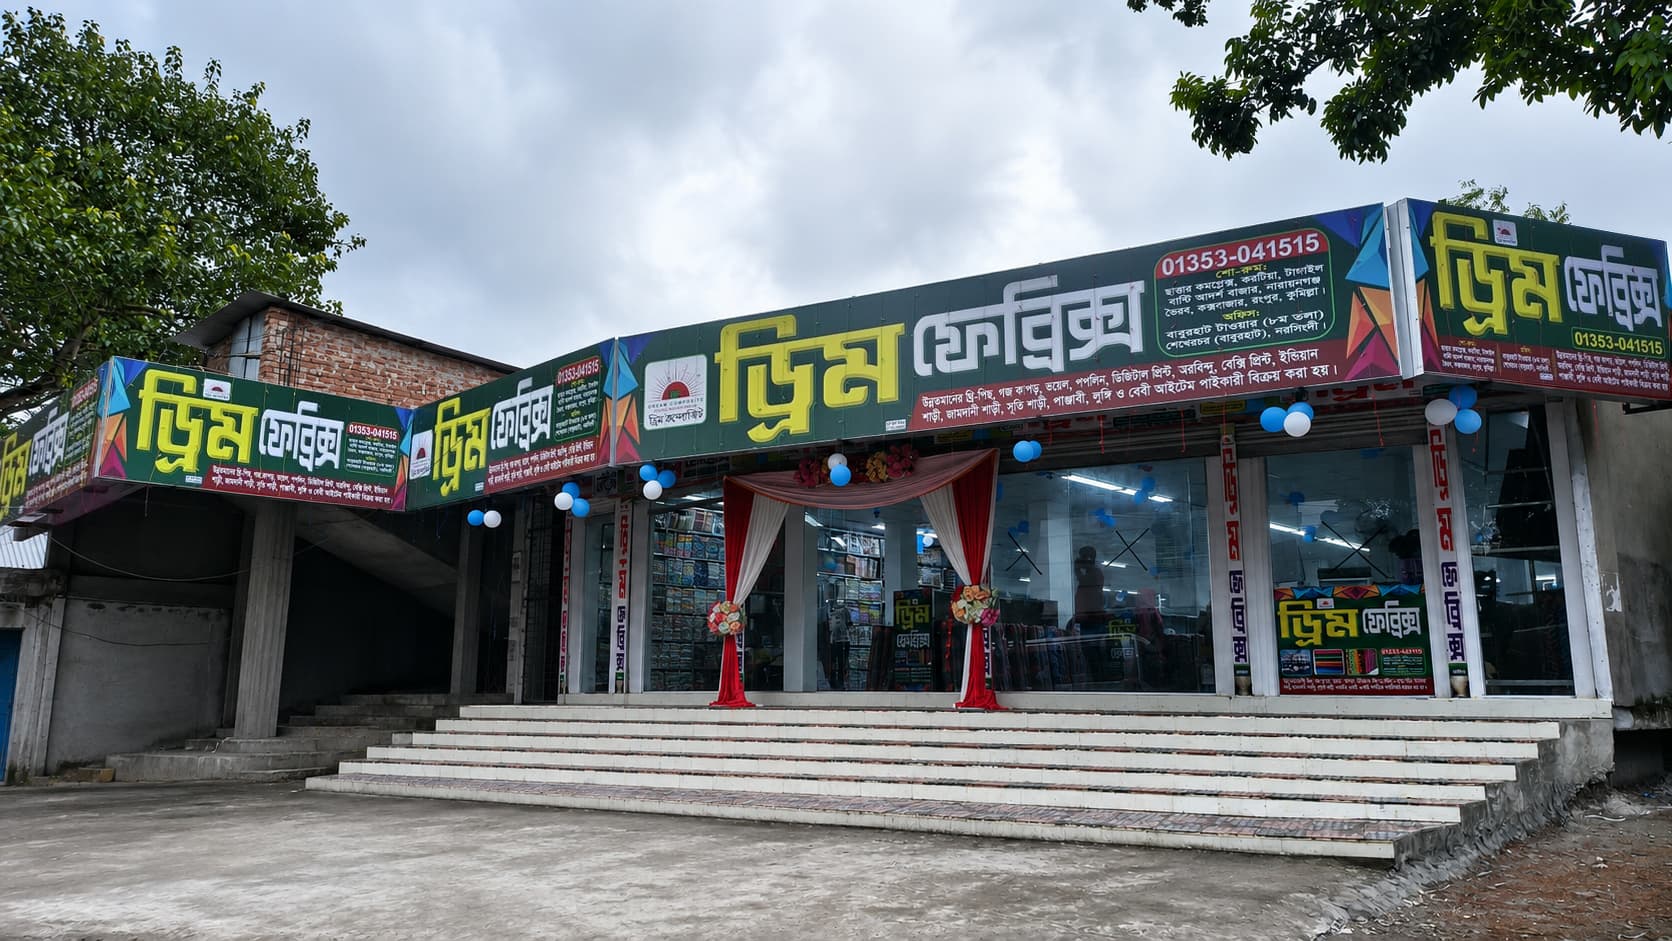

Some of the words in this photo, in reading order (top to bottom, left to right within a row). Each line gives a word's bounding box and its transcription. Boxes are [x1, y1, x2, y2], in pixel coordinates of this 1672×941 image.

[1160, 232, 1321, 276] 01353-041515
[1429, 211, 1563, 336] ড্রিম
[714, 314, 905, 443] ড্রিম
[914, 274, 1145, 377] ফেব্রিক্স
[1575, 331, 1663, 355] 01353-041515
[557, 359, 600, 385] 01353-041515
[946, 403, 980, 419] জামদানী
[1116, 389, 1125, 399] ও
[1128, 382, 1152, 398] বেবী
[1154, 379, 1196, 395] আইটেম
[1199, 371, 1245, 389] পাইকারী
[1247, 369, 1281, 384] বিক্রয়
[1284, 366, 1308, 380] করা
[1310, 364, 1330, 378] হয়
[998, 386, 1013, 398] গজ
[1111, 369, 1149, 384] ডিজিটাল
[136, 368, 259, 474] ড্রিম
[349, 424, 398, 440] 01353-041515
[433, 397, 492, 497] ড্রিম
[895, 598, 930, 630] ড্রিম
[1277, 599, 1359, 647] ড্রিম
